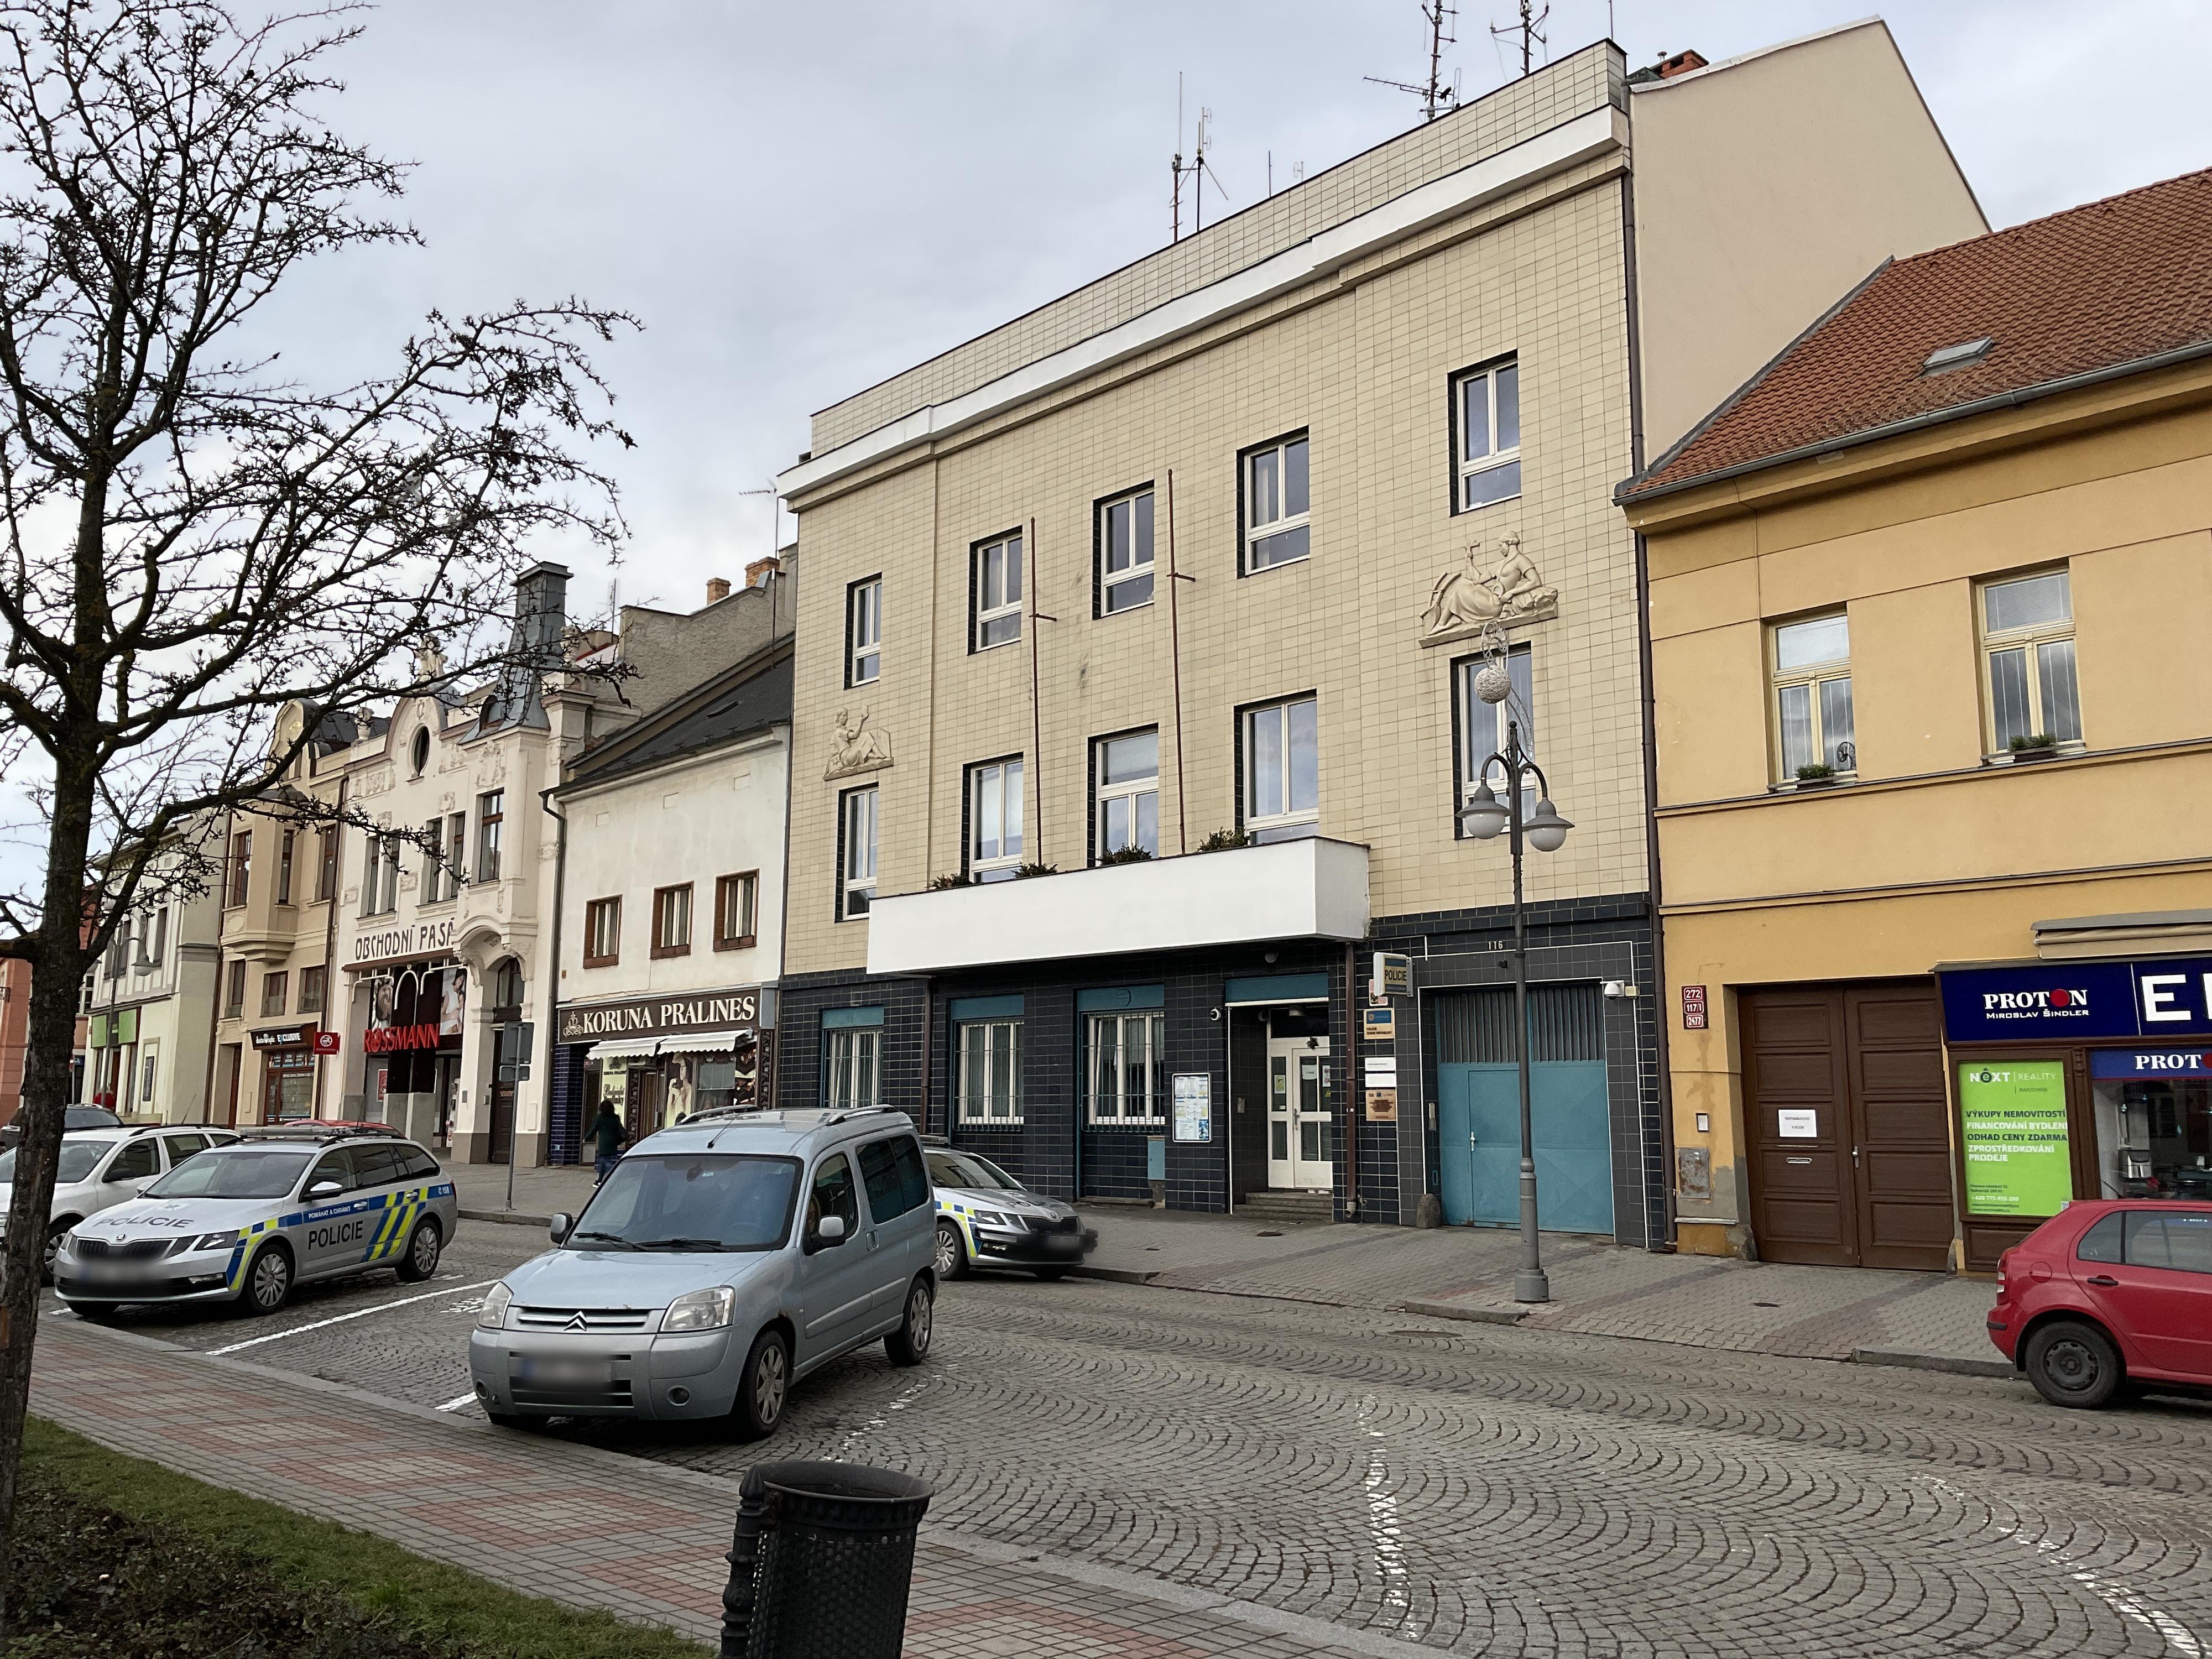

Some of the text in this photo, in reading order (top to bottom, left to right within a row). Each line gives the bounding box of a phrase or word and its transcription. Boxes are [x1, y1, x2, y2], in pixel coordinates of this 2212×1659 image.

[356, 917, 456, 961] OBCHODNÍ PASÁ
[1488, 940, 1503, 950] 116
[1384, 969, 1407, 981] POLICIE
[1686, 989, 1700, 998] 272
[2141, 973, 2212, 1021] E
[1983, 989, 2088, 1009] PROTON
[583, 996, 755, 1034] KORUNA PRALINES
[2043, 1008, 2090, 1018] ŠINDLER
[363, 1024, 440, 1053] ROSSMANN
[2018, 1072, 2057, 1081] REALITY
[1966, 1109, 2066, 1118] VÝKUPY NEMOVITOSTÍ
[1966, 1121, 2027, 1130] FINANCOVÁNÍ
[1968, 1144, 2055, 1153] ZPROSTŘEDKOVÁNÍ
[308, 1209, 328, 1219] POMÁHAT
[93, 1217, 194, 1228] POLICIE
[308, 1220, 364, 1250] POLICIE
